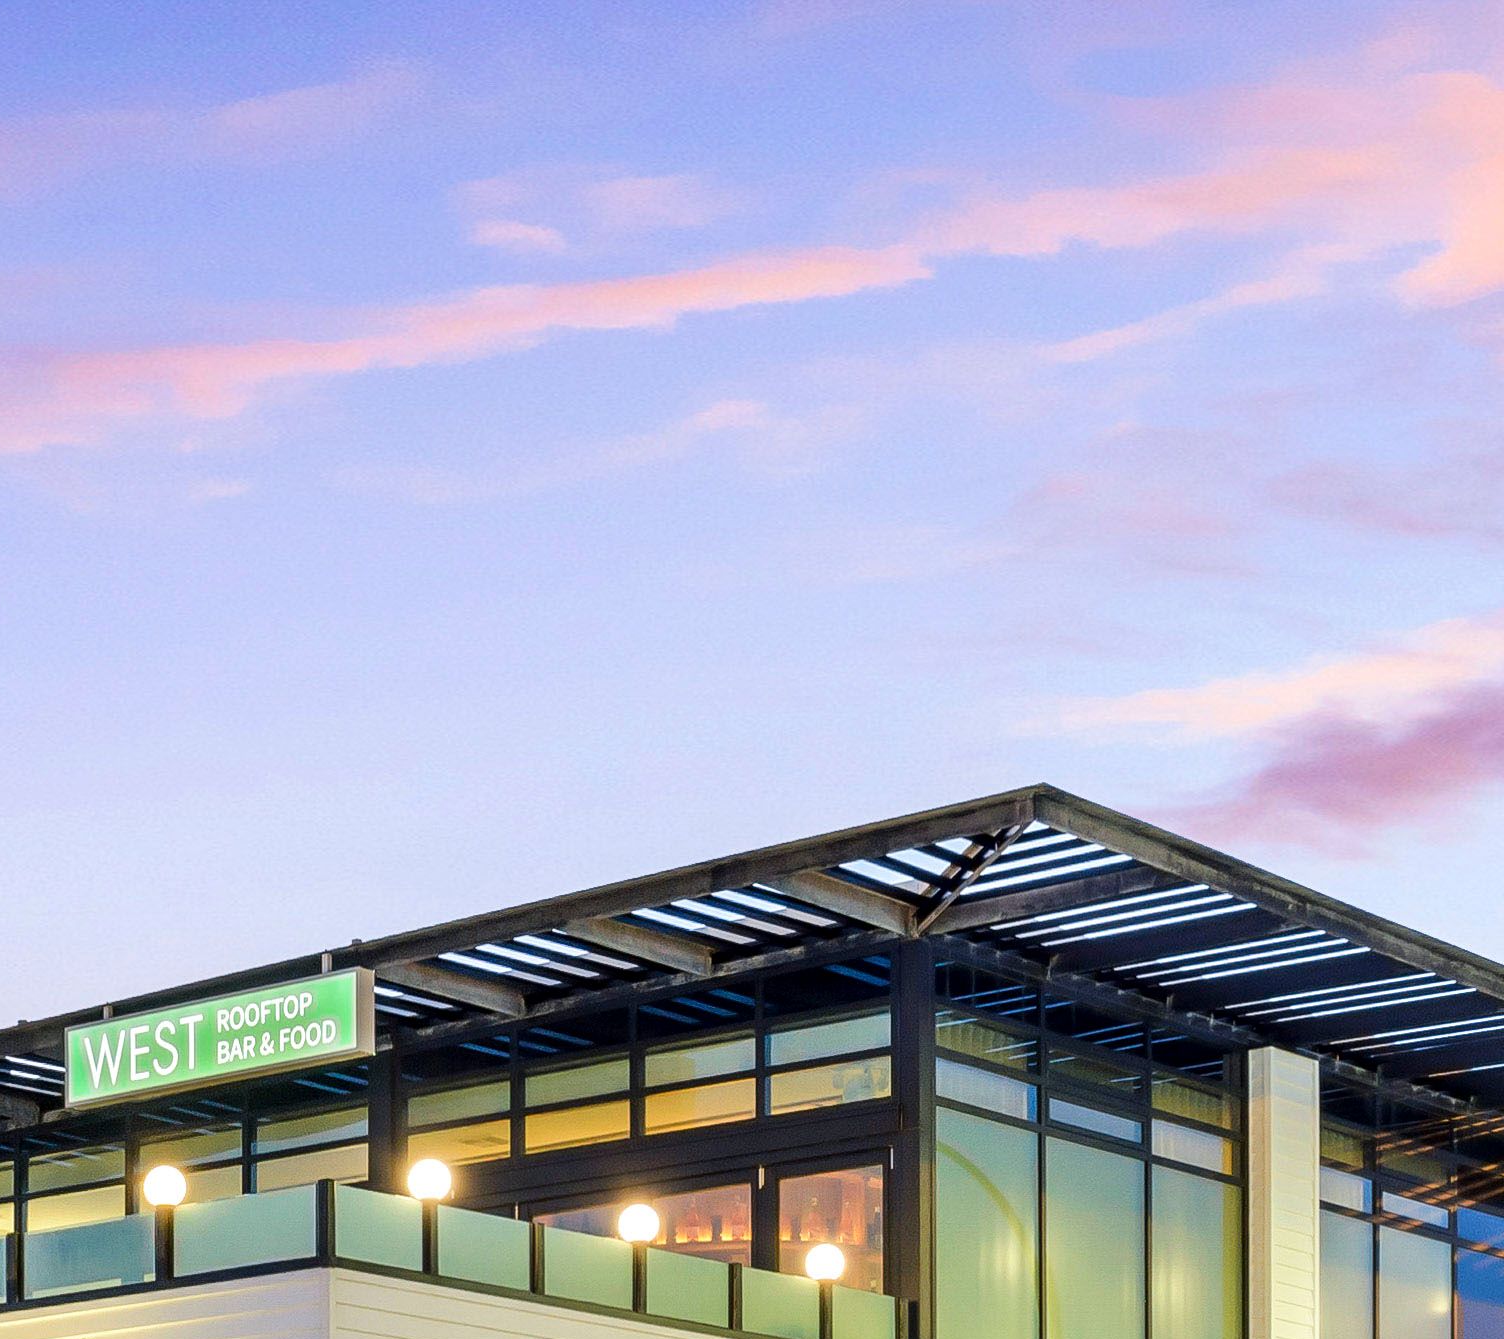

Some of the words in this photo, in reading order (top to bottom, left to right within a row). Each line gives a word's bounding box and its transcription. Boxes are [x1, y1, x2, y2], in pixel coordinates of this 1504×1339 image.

[216, 992, 313, 1033] ROOFTOP
[83, 1014, 203, 1089] WEST
[217, 1035, 256, 1065] BAR
[259, 1031, 275, 1055] &
[279, 1020, 337, 1052] FOOD
